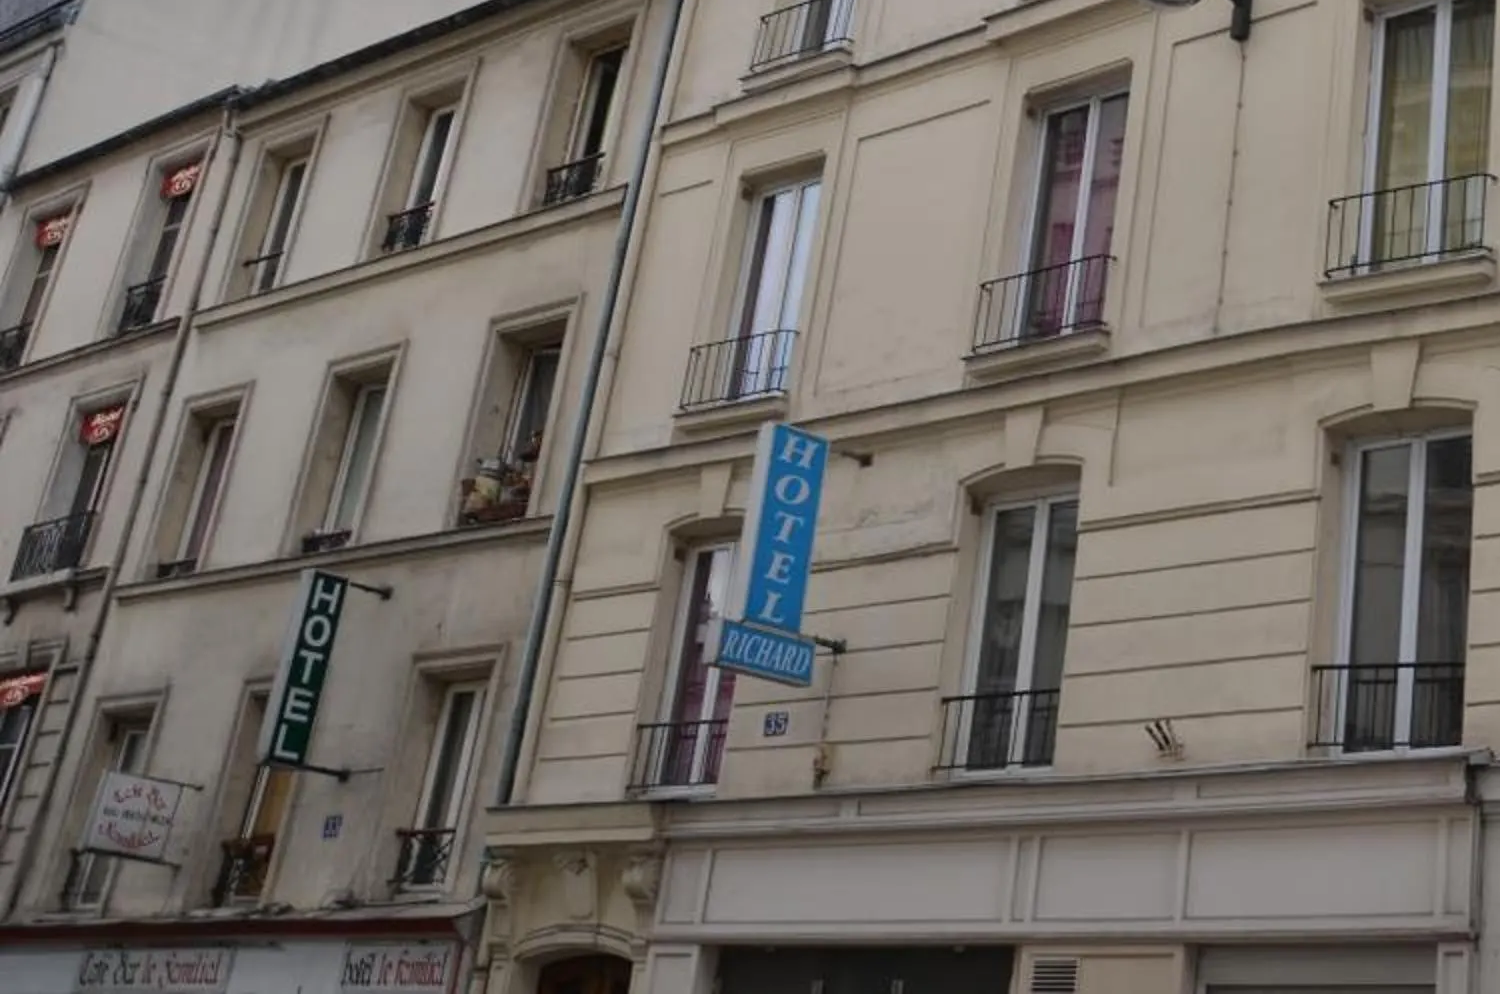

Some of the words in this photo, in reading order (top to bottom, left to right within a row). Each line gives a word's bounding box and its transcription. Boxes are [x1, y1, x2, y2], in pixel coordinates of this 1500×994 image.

[758, 432, 821, 624] HOTEL
[273, 578, 342, 760] HOTEL
[722, 629, 811, 673] RICHARD
[765, 713, 788, 736] 35
